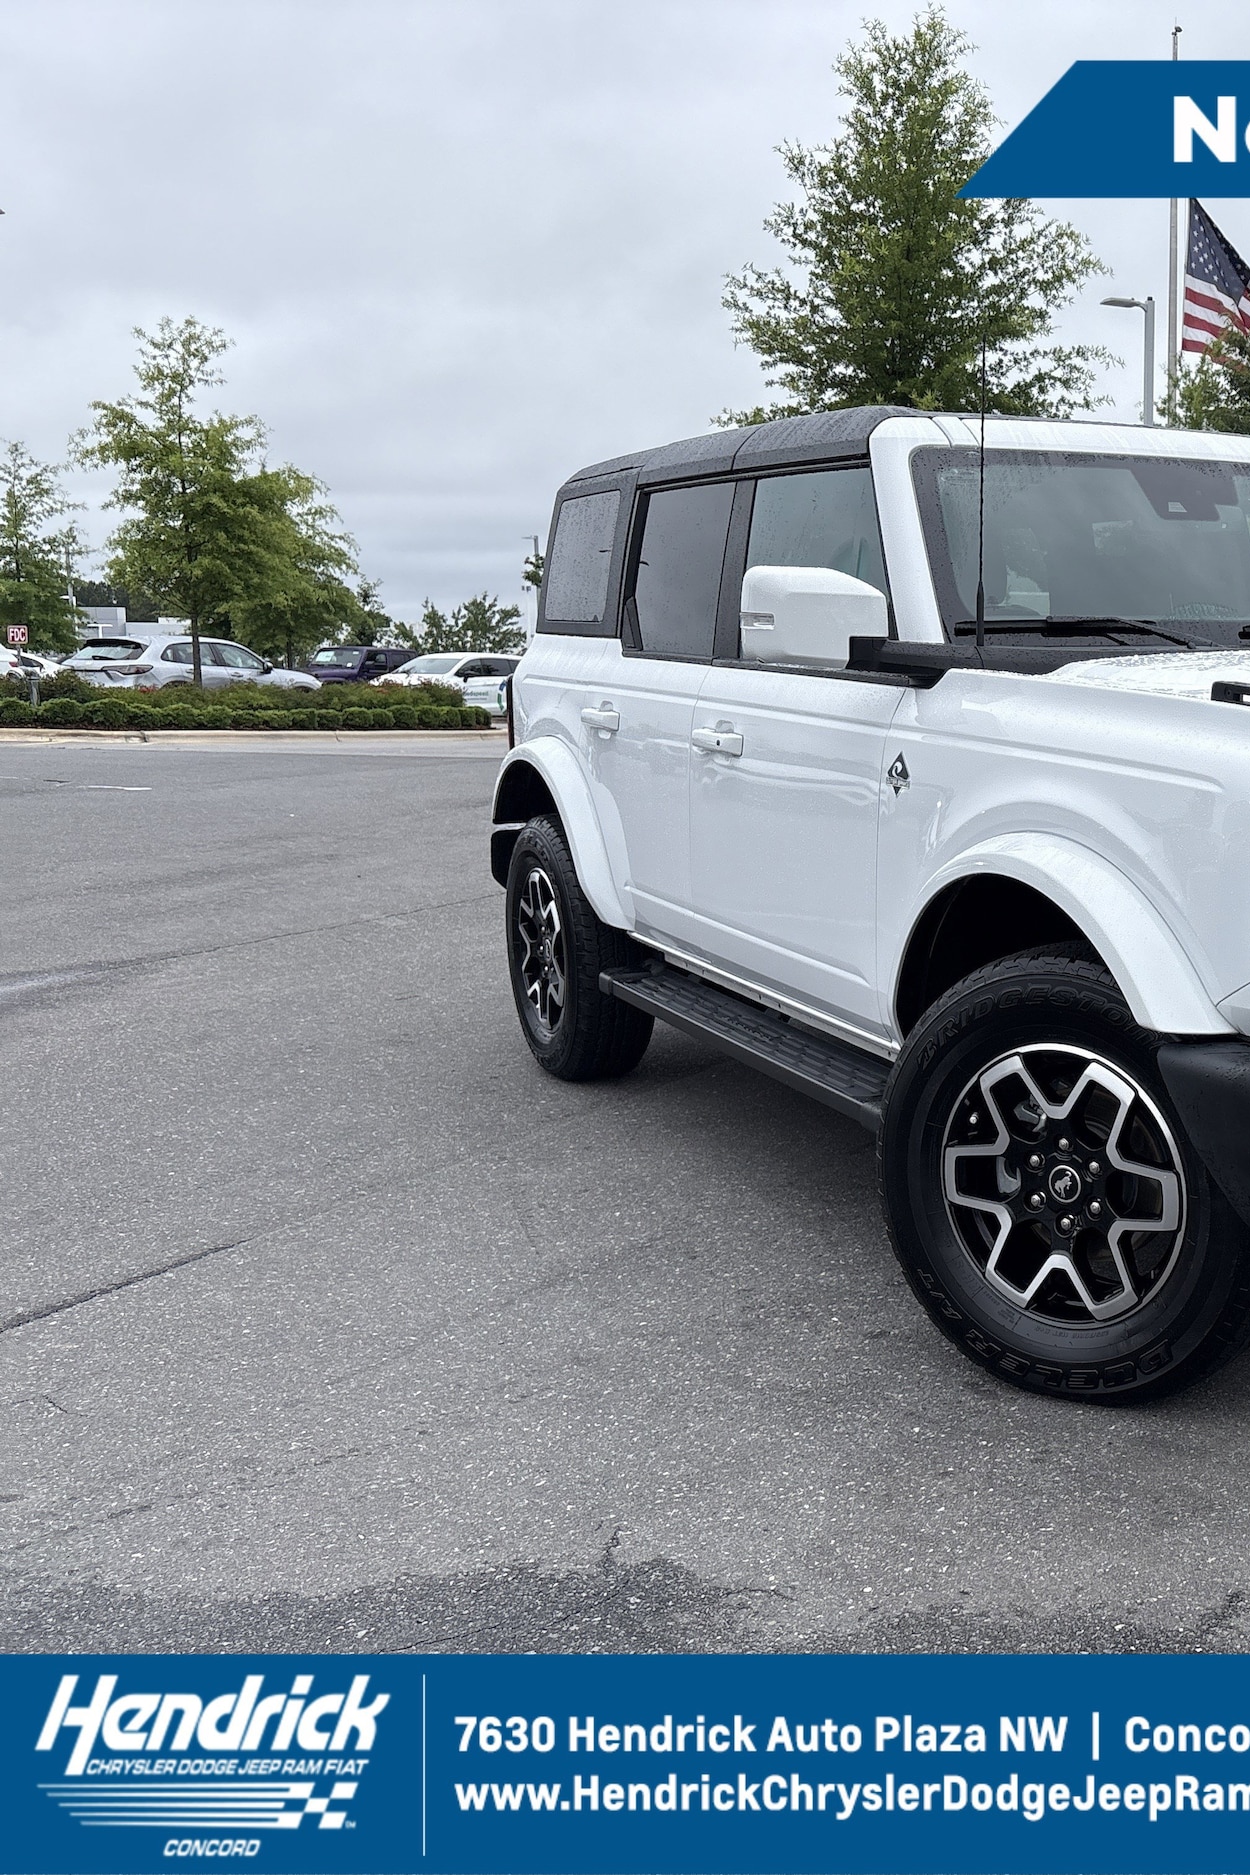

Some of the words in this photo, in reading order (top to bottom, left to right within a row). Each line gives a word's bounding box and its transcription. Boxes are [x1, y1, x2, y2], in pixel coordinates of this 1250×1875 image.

[9, 628, 26, 641] FDC
[917, 983, 1162, 1071] BRIDGESTON
[964, 1328, 1174, 1388] DUELER
